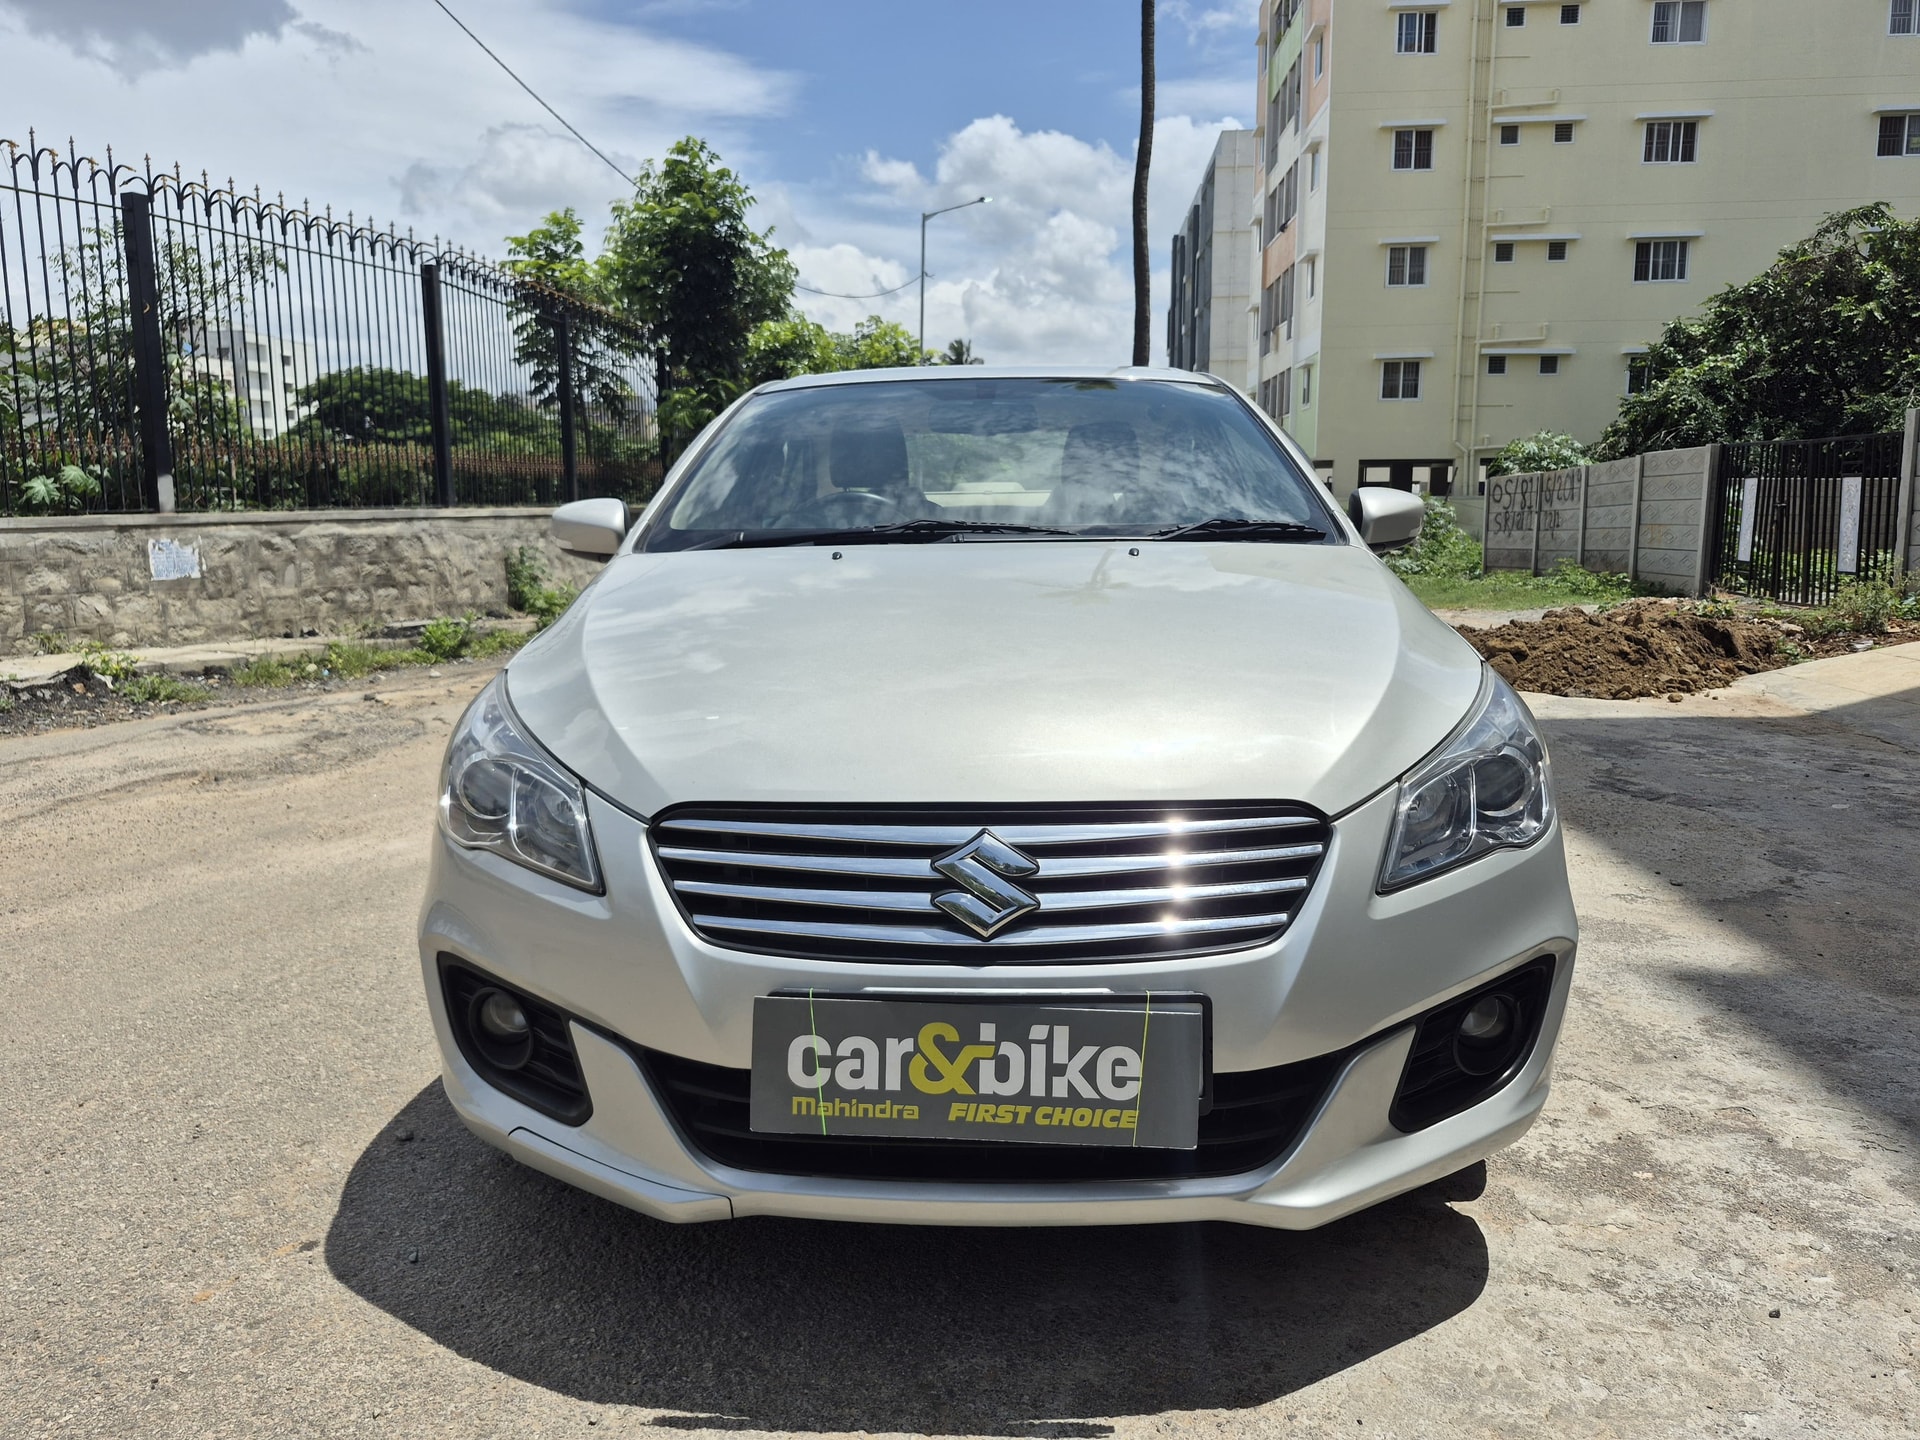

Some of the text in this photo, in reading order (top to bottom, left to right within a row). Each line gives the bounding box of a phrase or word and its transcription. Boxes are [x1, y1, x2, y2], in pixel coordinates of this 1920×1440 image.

[792, 1096, 1139, 1129] Mahindra FIRST CHOICE
